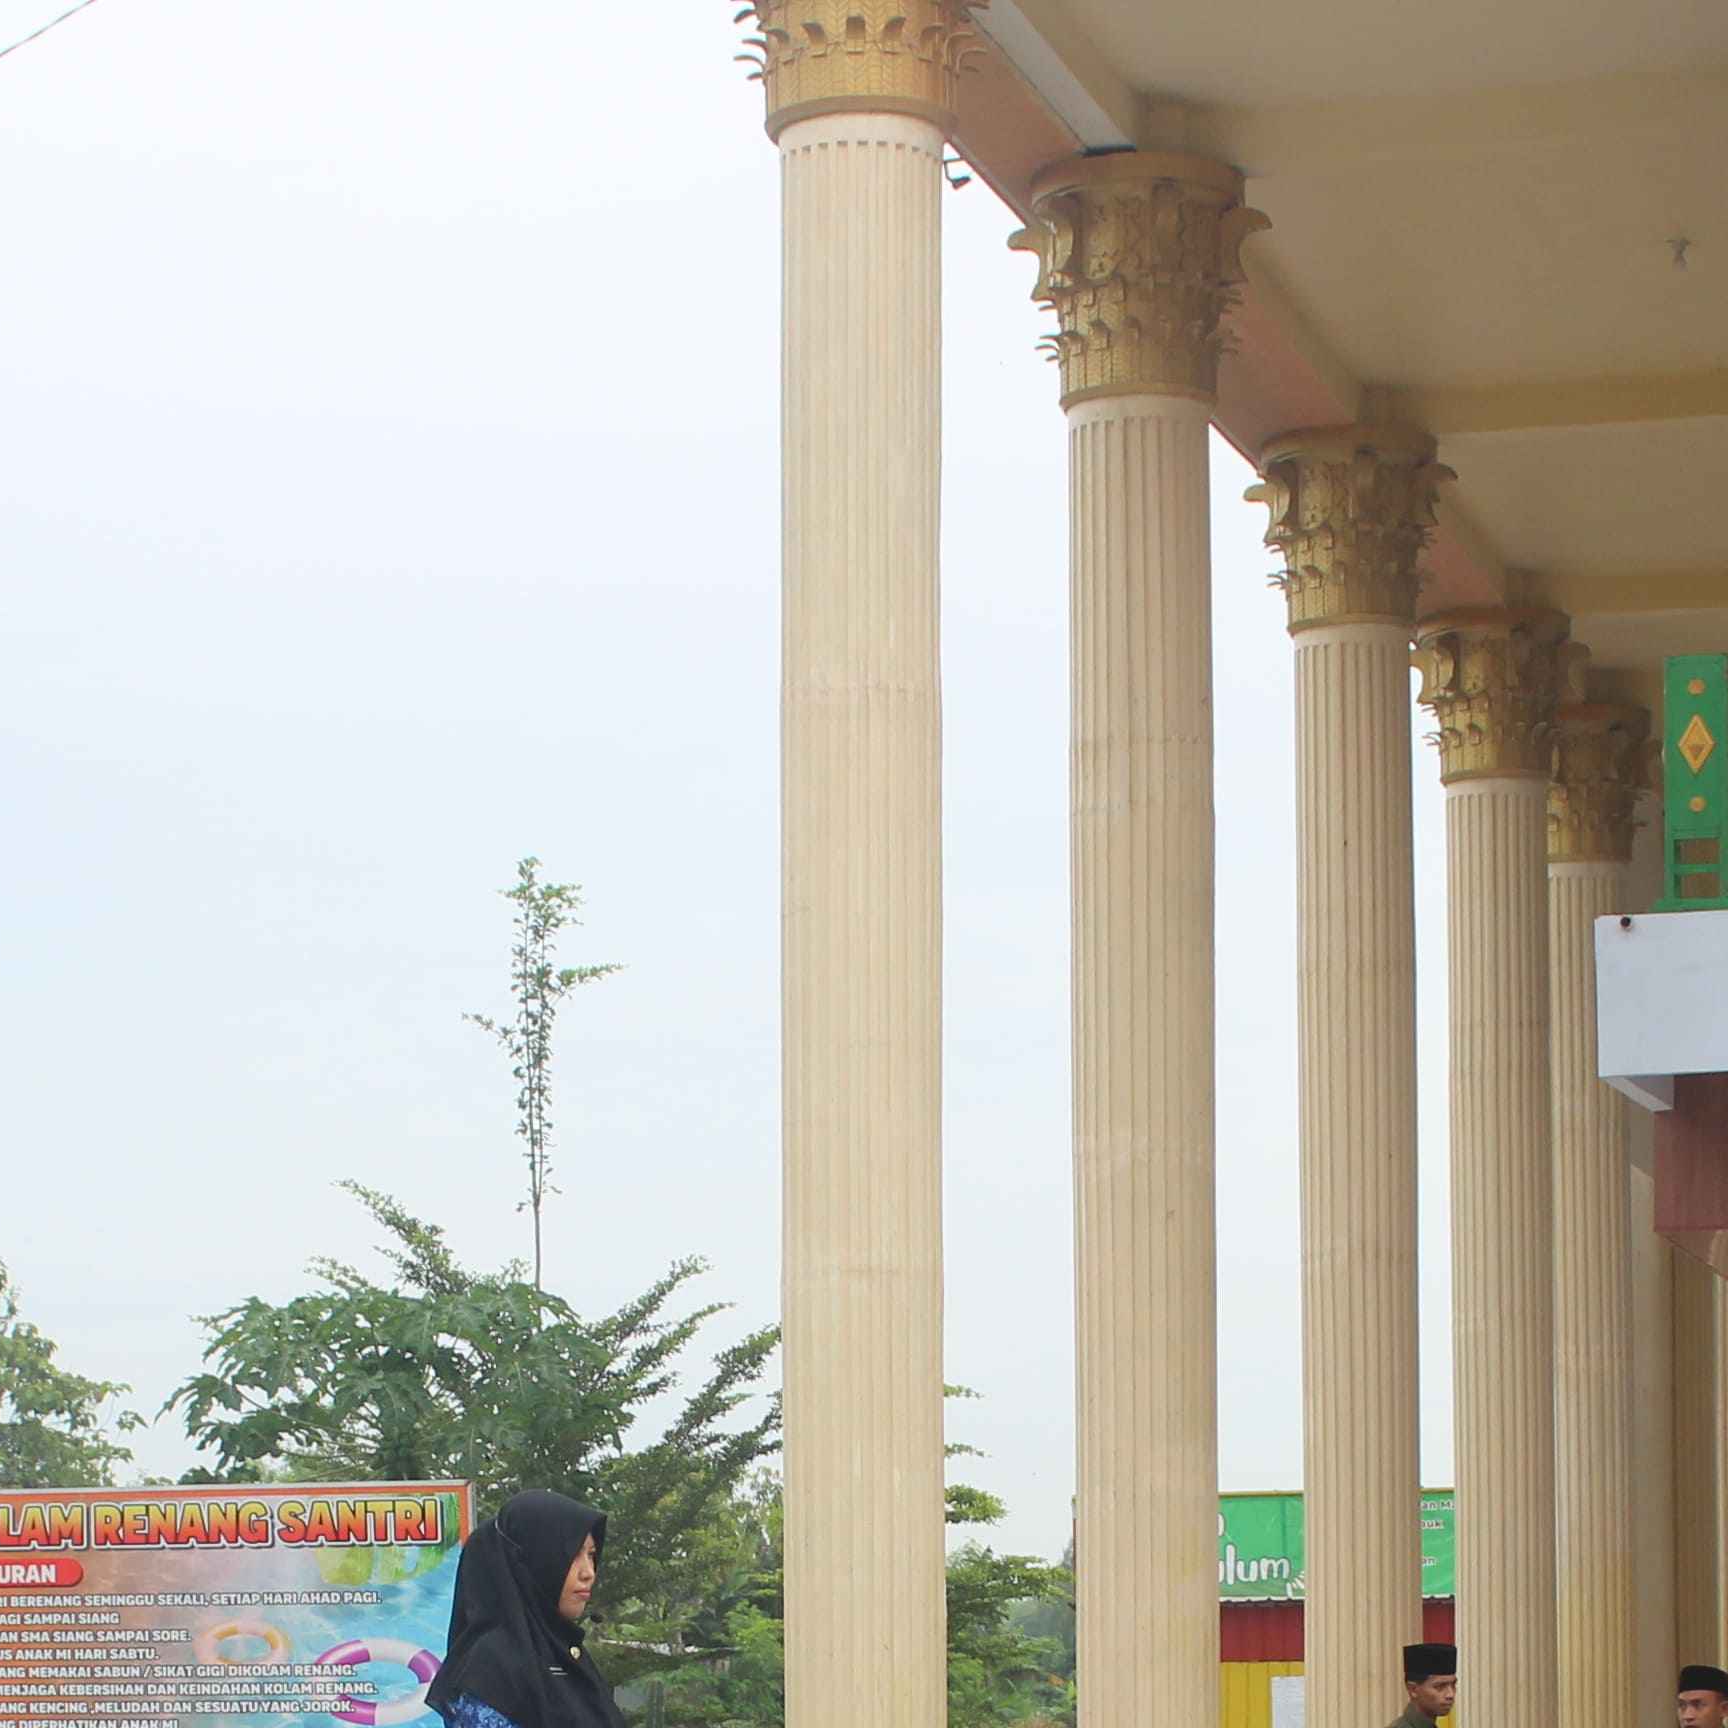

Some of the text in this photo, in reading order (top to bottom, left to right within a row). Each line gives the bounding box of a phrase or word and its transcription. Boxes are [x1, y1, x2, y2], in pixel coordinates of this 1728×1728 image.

[90, 1500, 273, 1549] RENANG
[276, 1497, 442, 1546] SANTRI
[10, 1595, 82, 1608] BERENANG
[84, 1594, 154, 1607] SEMINGGU
[157, 1594, 210, 1607] SEKALI,
[211, 1593, 260, 1606] SETIAP
[263, 1592, 297, 1604] HARI
[298, 1592, 341, 1604] AHAD
[343, 1591, 382, 1604] PAGI.
[23, 1613, 76, 1625] SAMPAI
[78, 1612, 120, 1625] SIANG
[22, 1630, 50, 1643] SMA
[53, 1630, 95, 1643] SIANG
[97, 1630, 149, 1642] SAMPAI
[152, 1629, 191, 1642] SORE.
[15, 1649, 54, 1661] ANAK
[55, 1649, 72, 1660] MI
[74, 1649, 108, 1660] HARI
[110, 1648, 160, 1660] SABTU.
[28, 1666, 91, 1678] MEMAKAI
[93, 1666, 140, 1678] SABUN
[143, 1666, 151, 1678] /
[153, 1665, 192, 1678] SIKAT
[196, 1666, 225, 1677] GIGI
[228, 1665, 291, 1677] DIKOLAM
[294, 1665, 356, 1677] RENANG.
[59, 1684, 145, 1696] KEBERSIHAN
[147, 1684, 177, 1696] DAN
[179, 1683, 261, 1695] KEINDAHAN
[263, 1683, 312, 1695] KOLAM
[316, 1682, 378, 1694] RENANG.
[29, 1702, 88, 1714] KENCING
[163, 1702, 193, 1713] DAN
[194, 1701, 259, 1714] SESUATU
[260, 1701, 300, 1713] YANG
[302, 1701, 355, 1713] JOROK.
